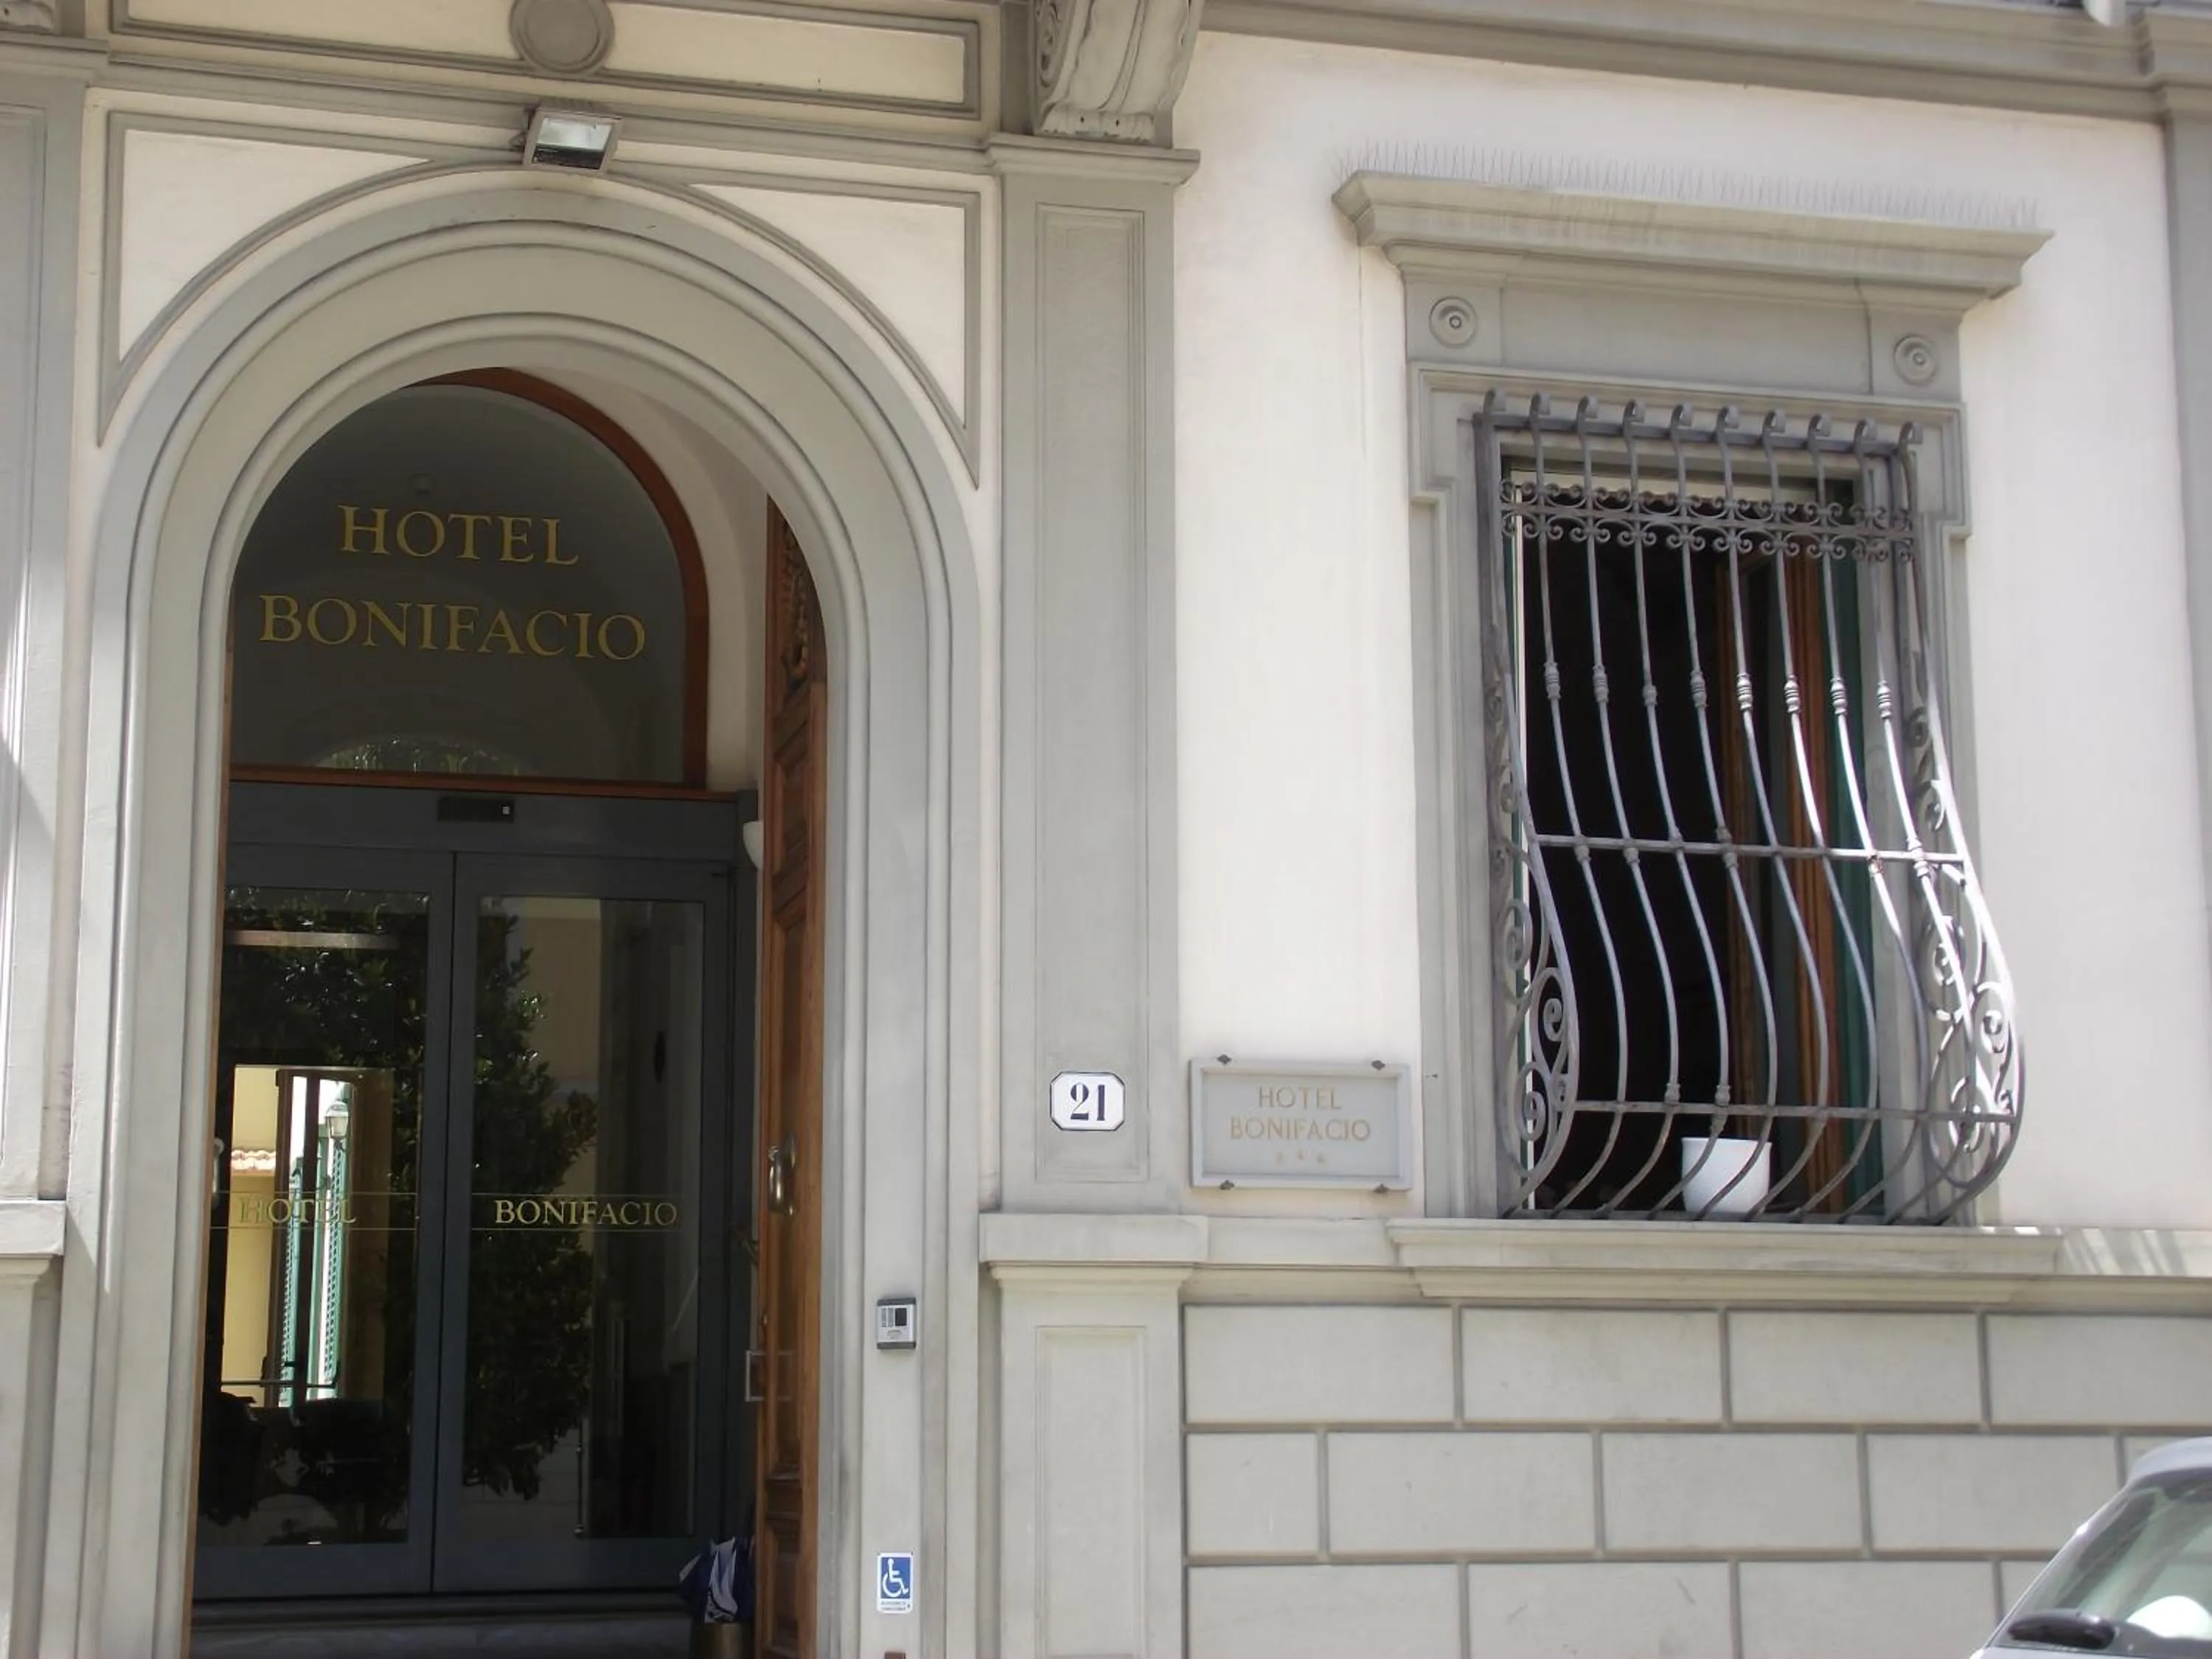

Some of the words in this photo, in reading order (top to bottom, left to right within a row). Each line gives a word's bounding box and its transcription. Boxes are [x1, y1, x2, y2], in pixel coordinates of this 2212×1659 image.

[337, 504, 579, 566] HOTEL
[259, 594, 647, 661] BONIFACIO
[1070, 1082, 1106, 1121] 21
[1259, 1085, 1342, 1110] HOTEL
[1230, 1116, 1371, 1141] BONIFACIO
[494, 1199, 678, 1226] BONIFACIO
